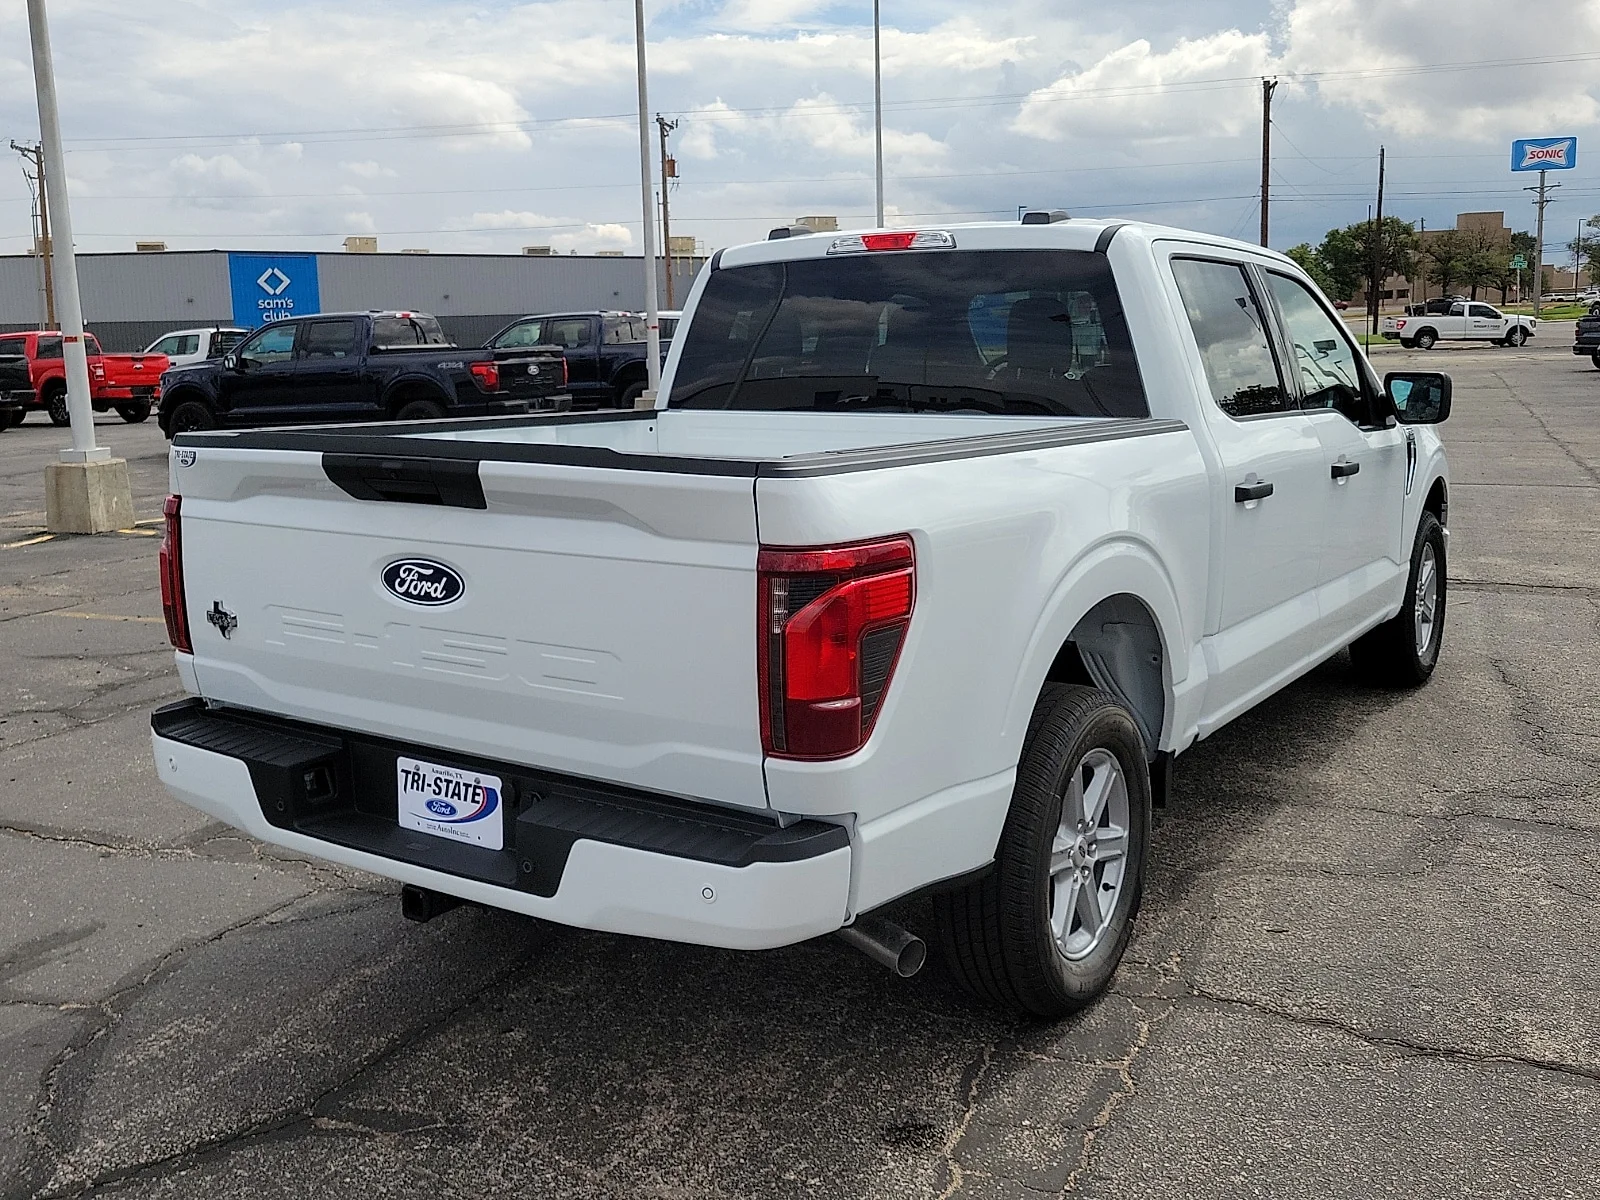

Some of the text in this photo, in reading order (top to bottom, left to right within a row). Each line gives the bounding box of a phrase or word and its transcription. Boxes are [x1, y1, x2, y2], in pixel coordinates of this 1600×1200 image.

[1528, 149, 1564, 160] SONIC
[257, 297, 294, 309] sam's
[262, 309, 291, 322] club
[394, 564, 447, 599] Ford
[455, 772, 463, 780] TX
[400, 768, 482, 805] TRI-STATE
[431, 800, 451, 815] Ford
